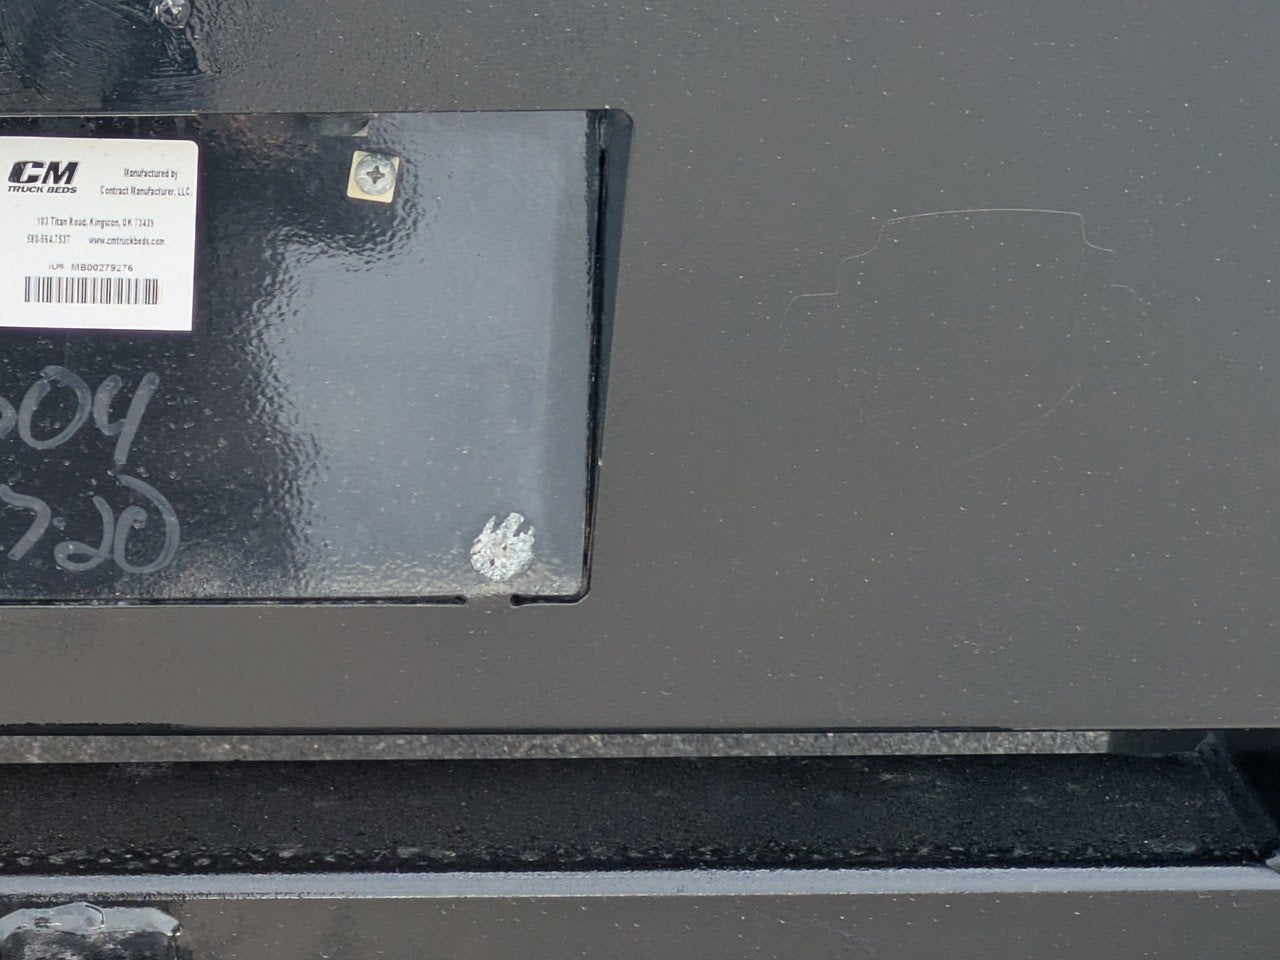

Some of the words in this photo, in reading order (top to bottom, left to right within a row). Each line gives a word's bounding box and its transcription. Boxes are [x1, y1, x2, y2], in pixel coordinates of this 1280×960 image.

[7, 160, 79, 185] CM
[123, 168, 169, 178] Manufactured
[170, 169, 178, 180] by
[7, 185, 43, 193] TRUCK
[47, 186, 78, 194] BEDS
[100, 185, 129, 195] Contract
[50, 216, 69, 226] Titan
[88, 235, 165, 246] www.cmtruckbeds.com
